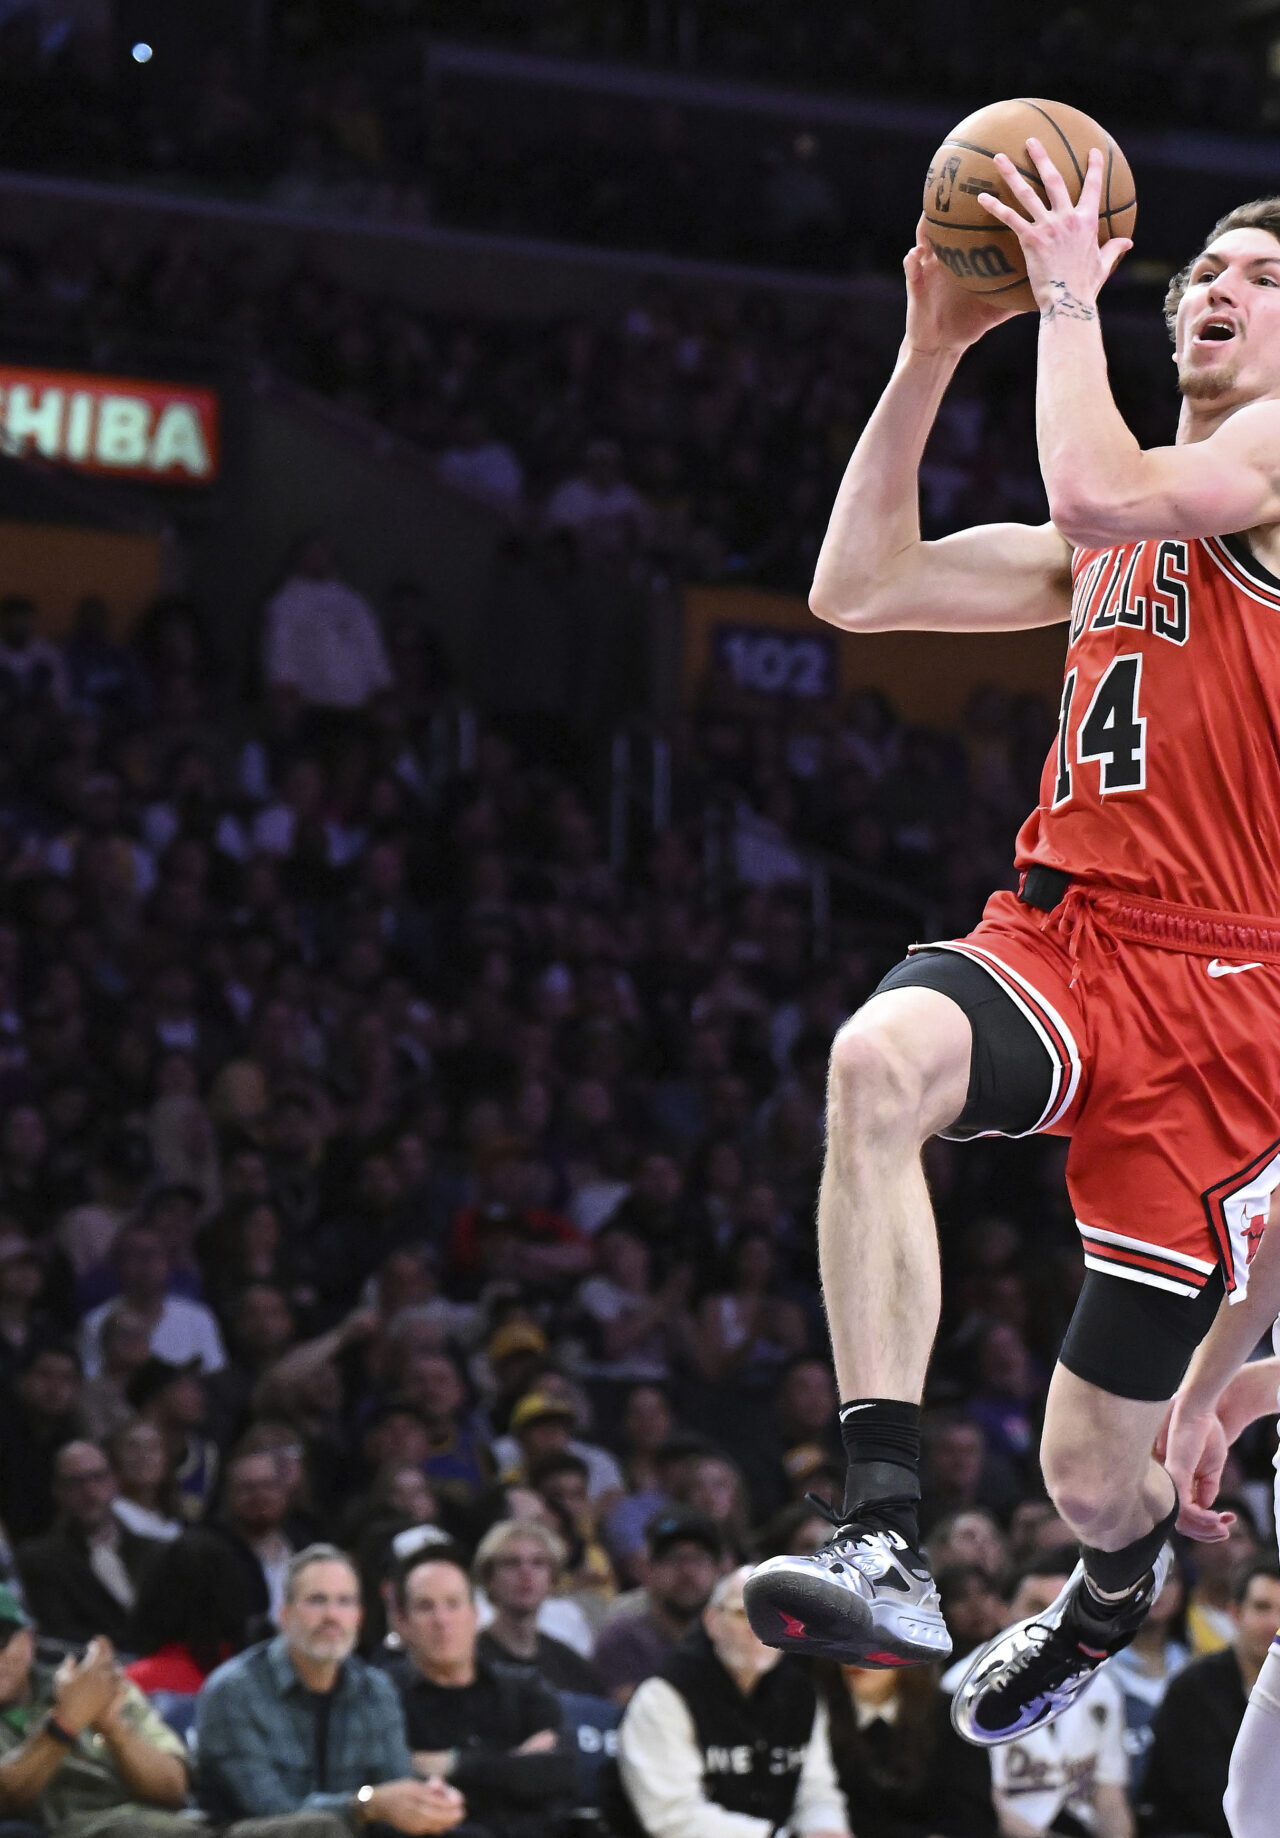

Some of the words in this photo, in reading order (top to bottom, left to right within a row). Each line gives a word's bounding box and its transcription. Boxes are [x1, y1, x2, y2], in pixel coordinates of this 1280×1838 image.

[0, 384, 207, 475] HIBA
[1070, 538, 1190, 648] ULLS
[724, 638, 826, 695] 102
[1051, 652, 1147, 811] 14
